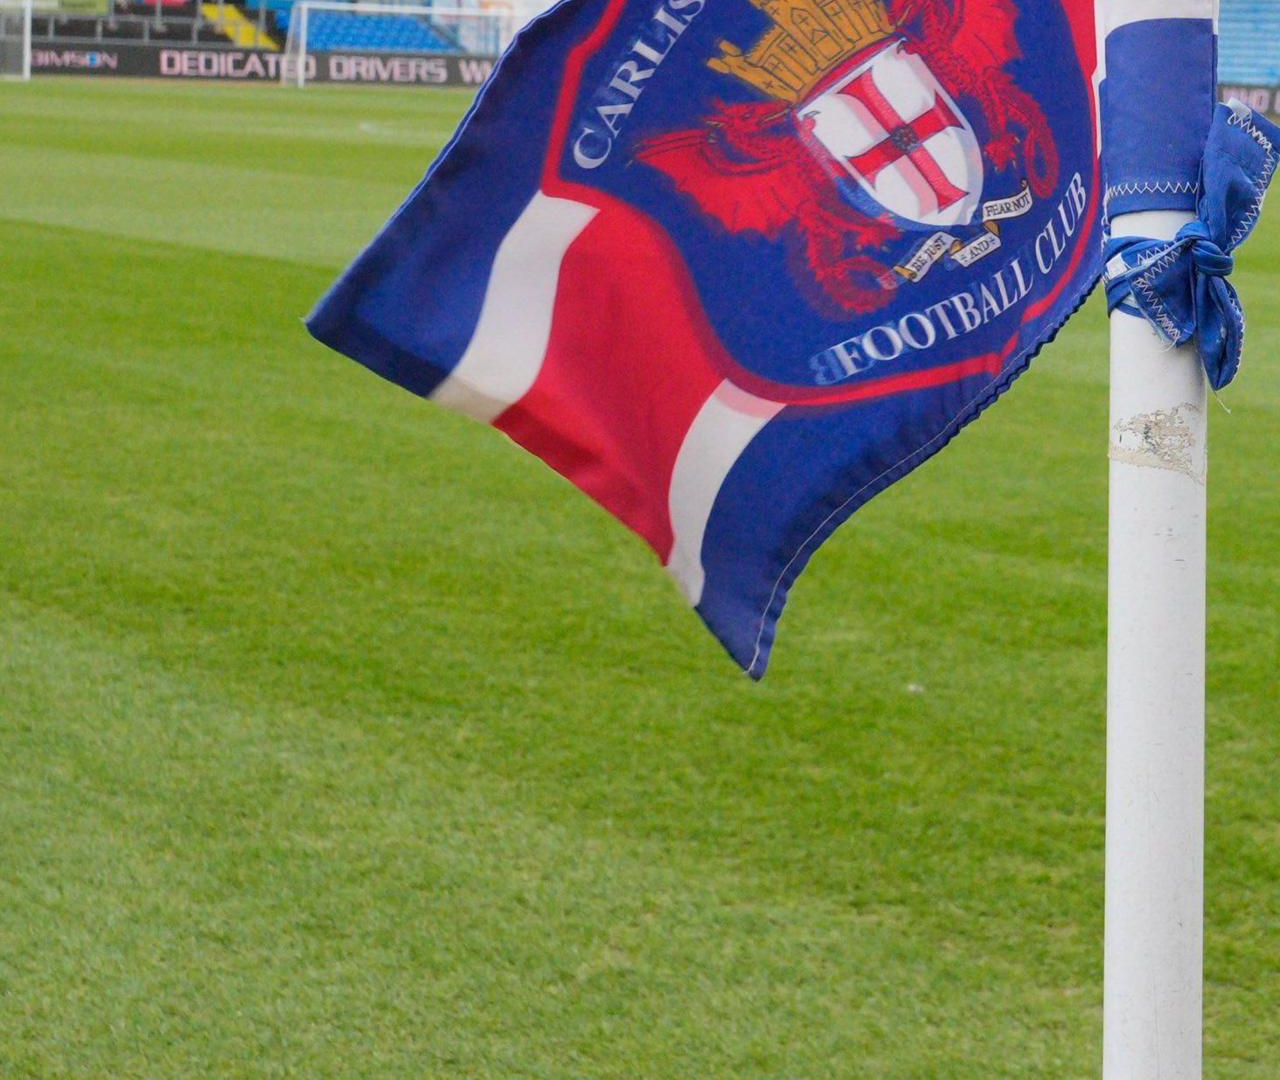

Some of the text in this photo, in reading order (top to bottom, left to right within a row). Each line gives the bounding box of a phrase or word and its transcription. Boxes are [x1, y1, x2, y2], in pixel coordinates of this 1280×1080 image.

[328, 55, 447, 83] DRIVERS
[832, 171, 1087, 376] FOOTBALL CLUB
